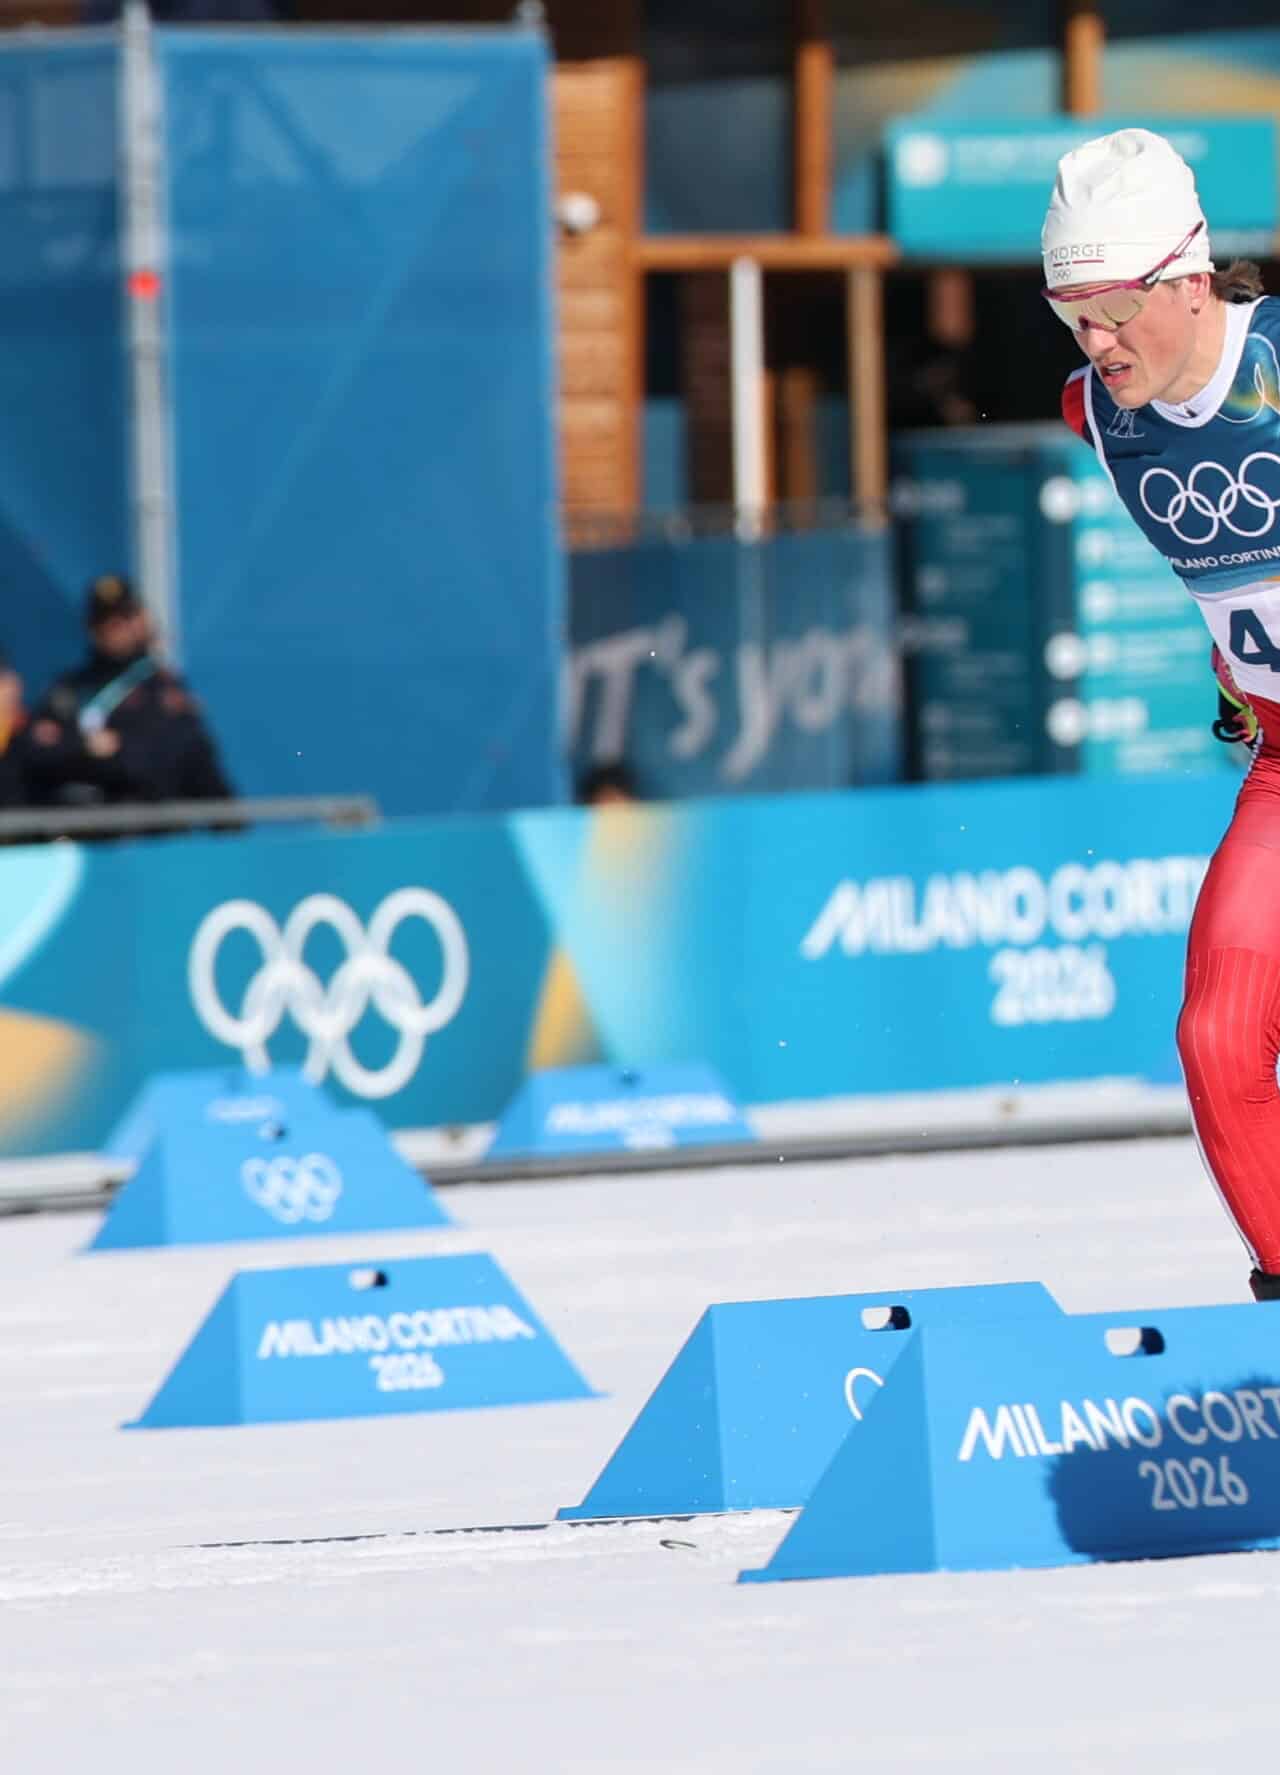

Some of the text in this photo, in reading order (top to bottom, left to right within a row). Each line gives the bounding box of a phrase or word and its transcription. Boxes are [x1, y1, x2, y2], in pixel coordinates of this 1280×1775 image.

[1050, 244, 1105, 259] NORGE
[802, 856, 1209, 958] MILANO CORT
[256, 1304, 536, 1358] MILANO CORTINA
[958, 1397, 1162, 1462] MILANO
[1139, 1456, 1249, 1511] 2026
